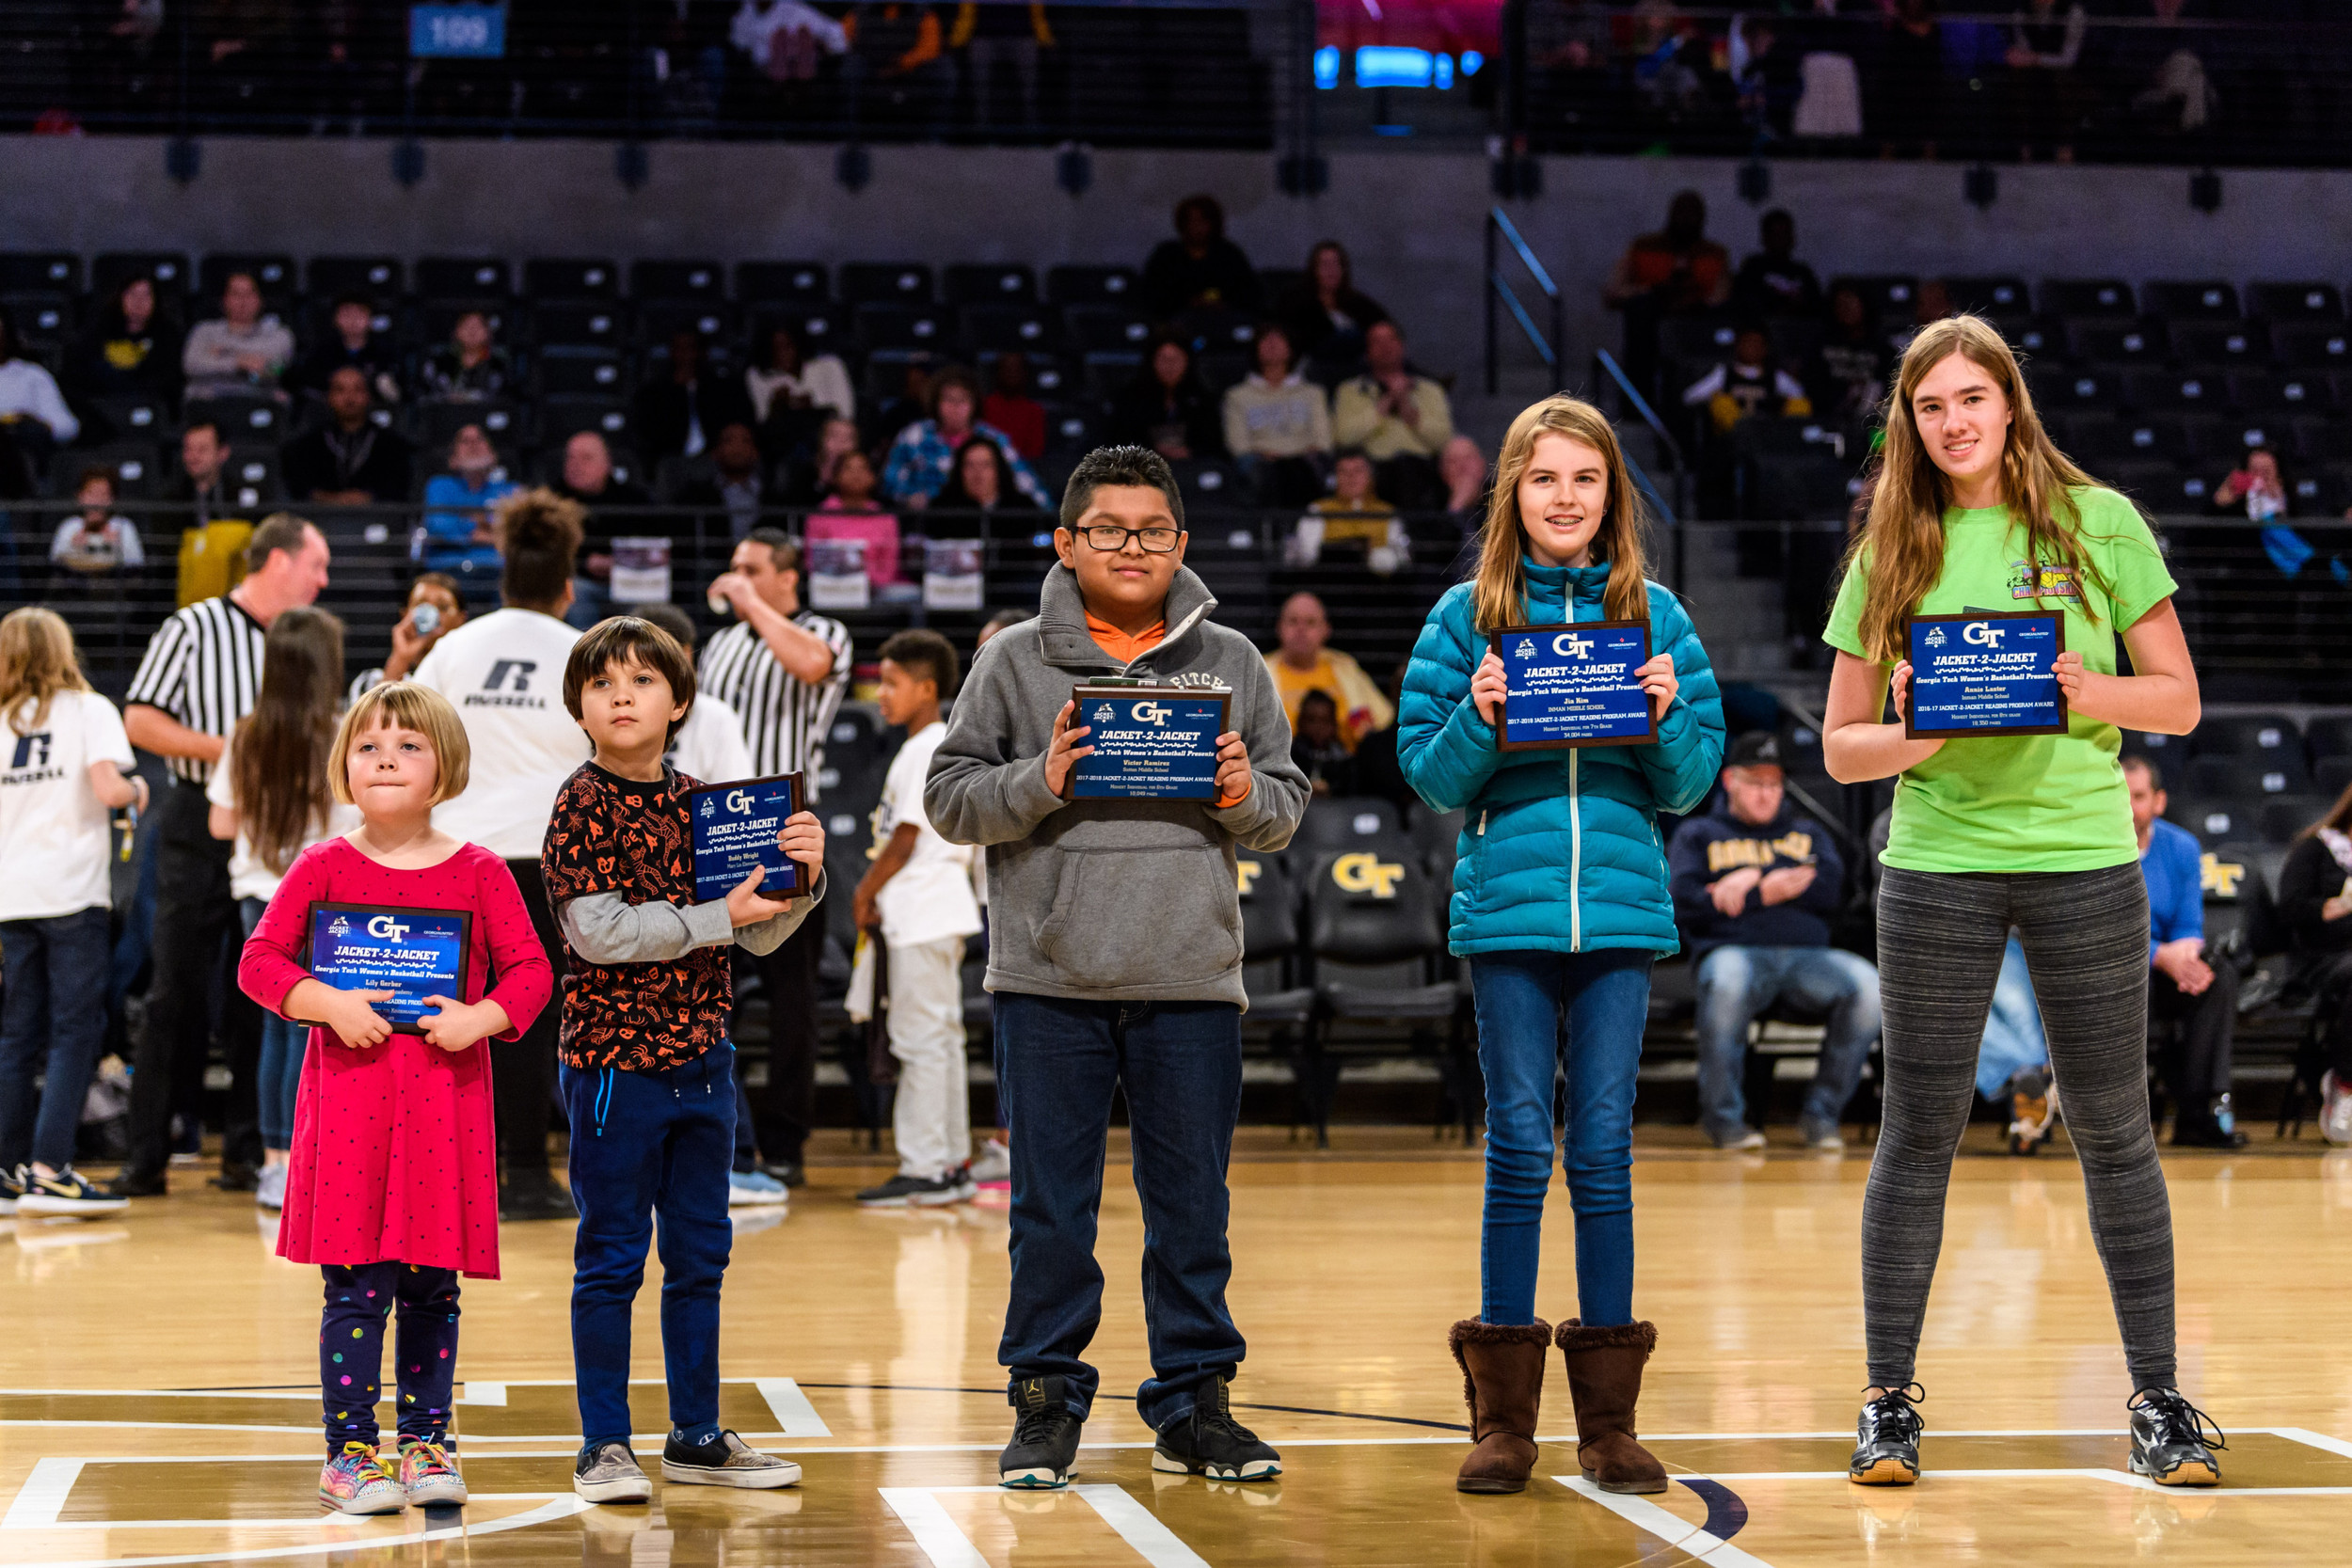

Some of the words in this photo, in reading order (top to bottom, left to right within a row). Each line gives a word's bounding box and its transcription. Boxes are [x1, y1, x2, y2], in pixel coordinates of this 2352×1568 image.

[1963, 622, 2005, 648] GT
[1552, 633, 1595, 659] GT
[1932, 652, 2038, 666] JACKET-2-JACKET
[1524, 663, 1627, 678] JACKET-2-JACKET
[1581, 685, 1614, 693] Basketball
[1131, 701, 1172, 726] GT
[1099, 730, 1200, 741] JACKET-2-JACKET
[725, 789, 755, 816] GT
[707, 816, 778, 836] JACKET-2-JACKET
[746, 838, 771, 848] Basketball
[1331, 852, 1405, 898] GT
[367, 915, 410, 943] GT
[334, 945, 439, 961] JACKET-2-JACKET
[315, 965, 340, 974] Georgia
[359, 967, 389, 976] Women's
[390, 969, 424, 978] Basketball
[425, 971, 455, 979] Presents
